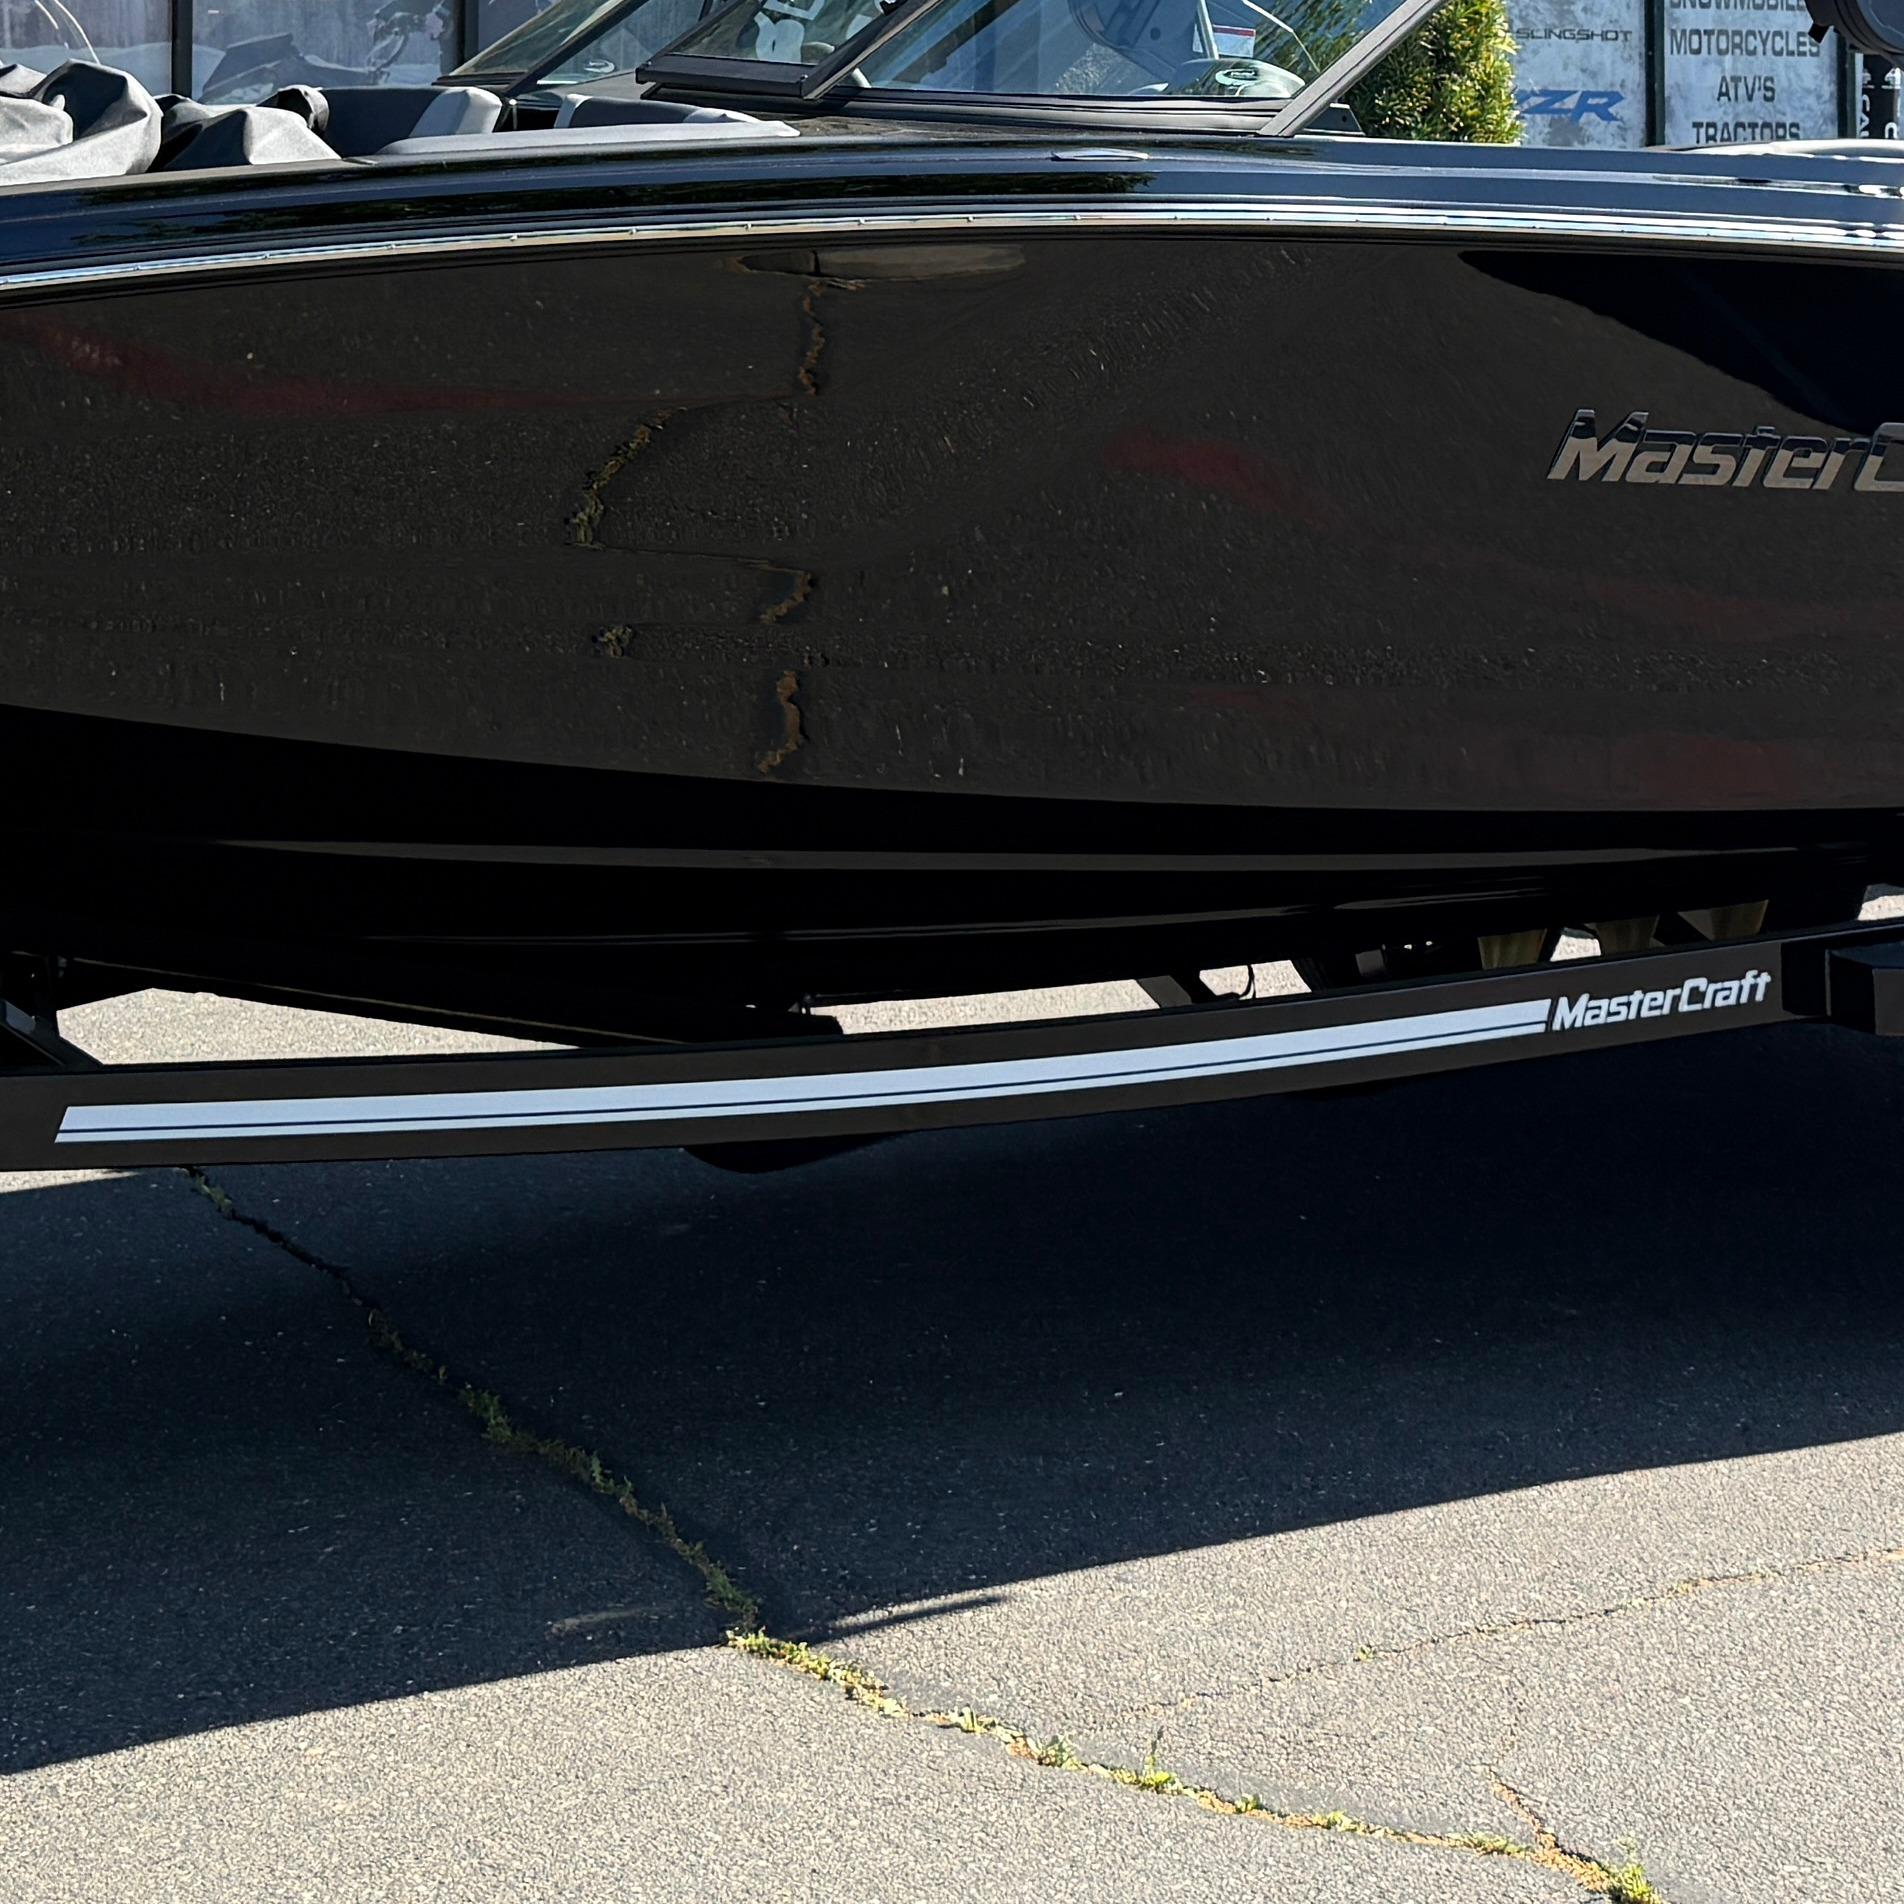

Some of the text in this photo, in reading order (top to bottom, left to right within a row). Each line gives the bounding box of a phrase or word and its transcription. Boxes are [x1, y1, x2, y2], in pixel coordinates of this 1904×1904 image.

[1515, 27, 1633, 43] SLINGSHOT
[1670, 28, 1821, 58] MOTORCYCLES
[1716, 75, 1776, 103] ATV'S
[1515, 88, 1625, 125] ZR
[1691, 121, 1801, 145] TRACTORS
[1552, 969, 1772, 1031] MasterCraft
